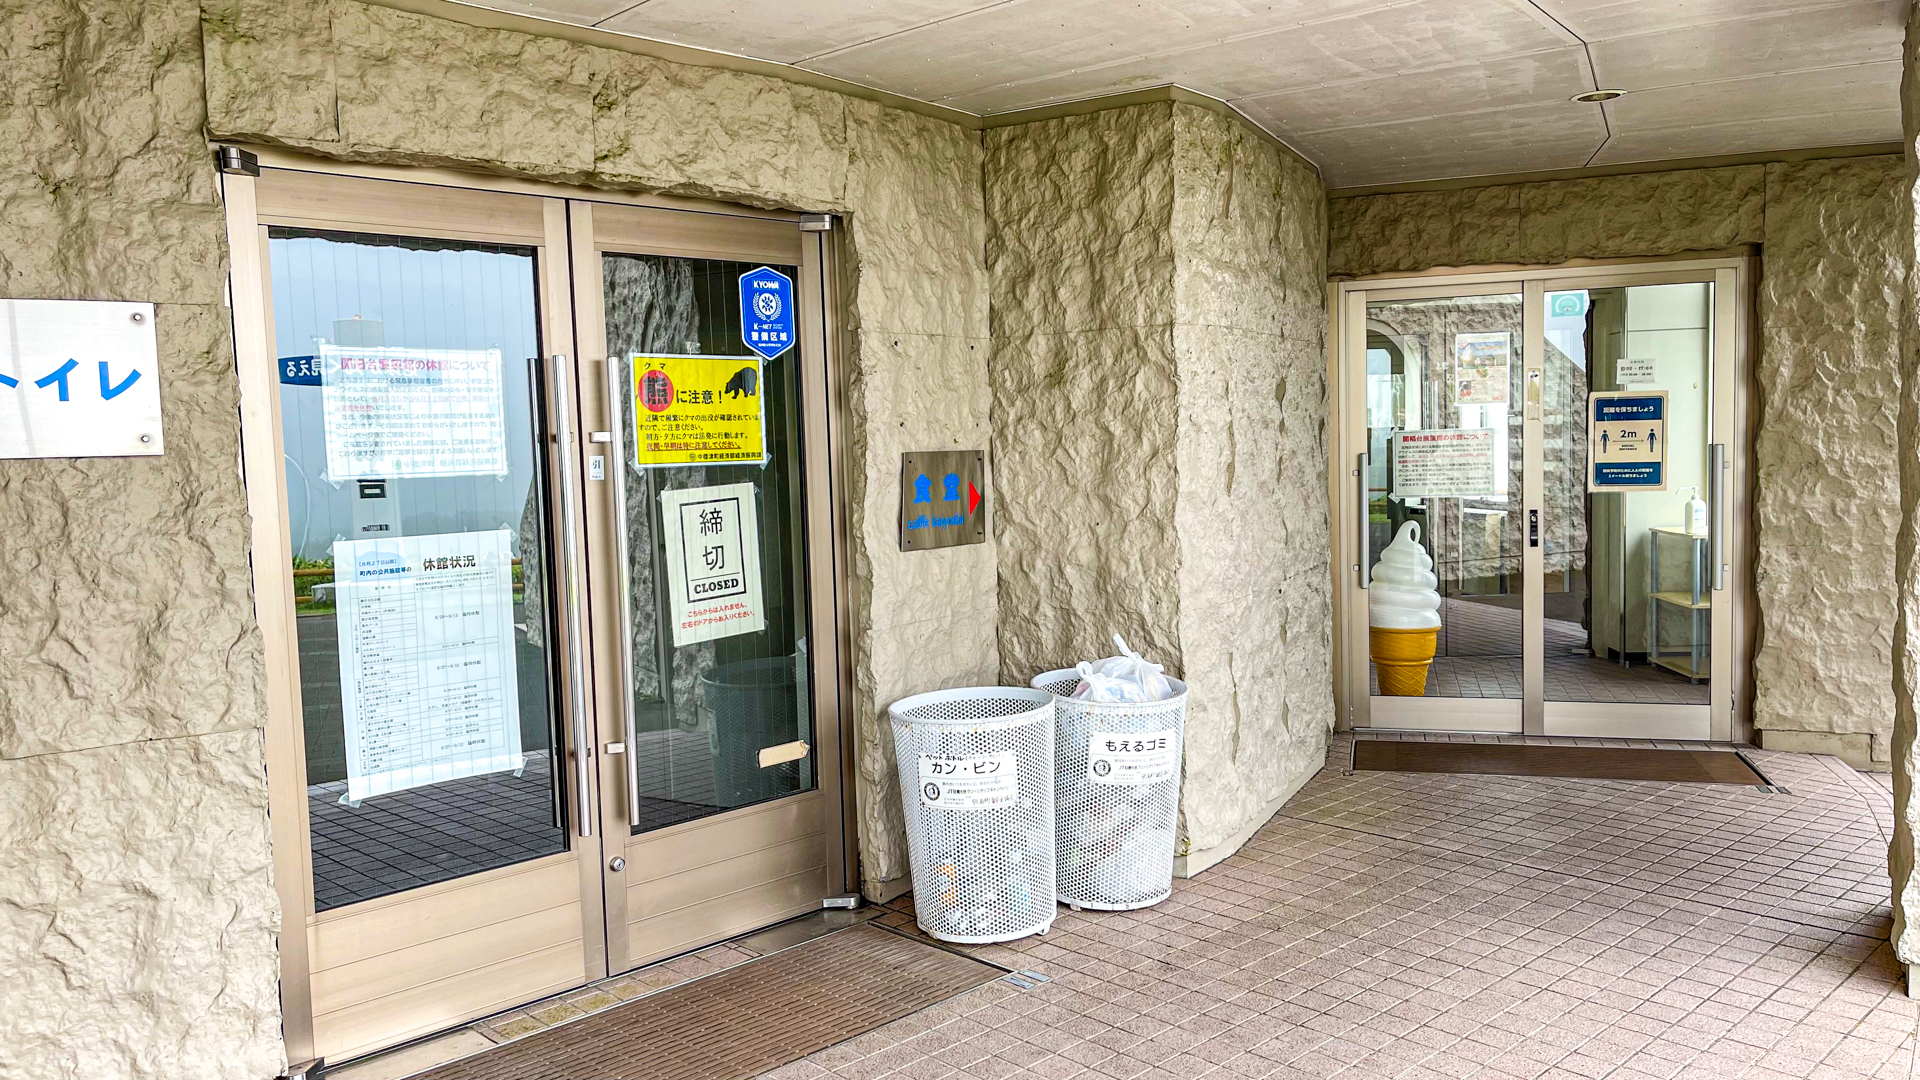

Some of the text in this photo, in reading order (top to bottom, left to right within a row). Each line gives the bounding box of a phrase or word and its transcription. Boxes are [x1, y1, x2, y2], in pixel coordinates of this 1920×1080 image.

[753, 279, 780, 289] KYOWA
[750, 331, 788, 342] 警備区域
[644, 362, 666, 370] クマ
[1603, 406, 1654, 414] 距離を保ちましょう
[638, 423, 704, 432] すので、ご注意ください。
[1620, 429, 1637, 438] 2m
[592, 460, 600, 469] 引
[913, 472, 960, 504] 食堂
[422, 554, 477, 571] 休館状況
[693, 577, 739, 595] CLOSED
[1105, 738, 1167, 752] もえるゴミ
[931, 761, 1001, 775] カン・ビン
